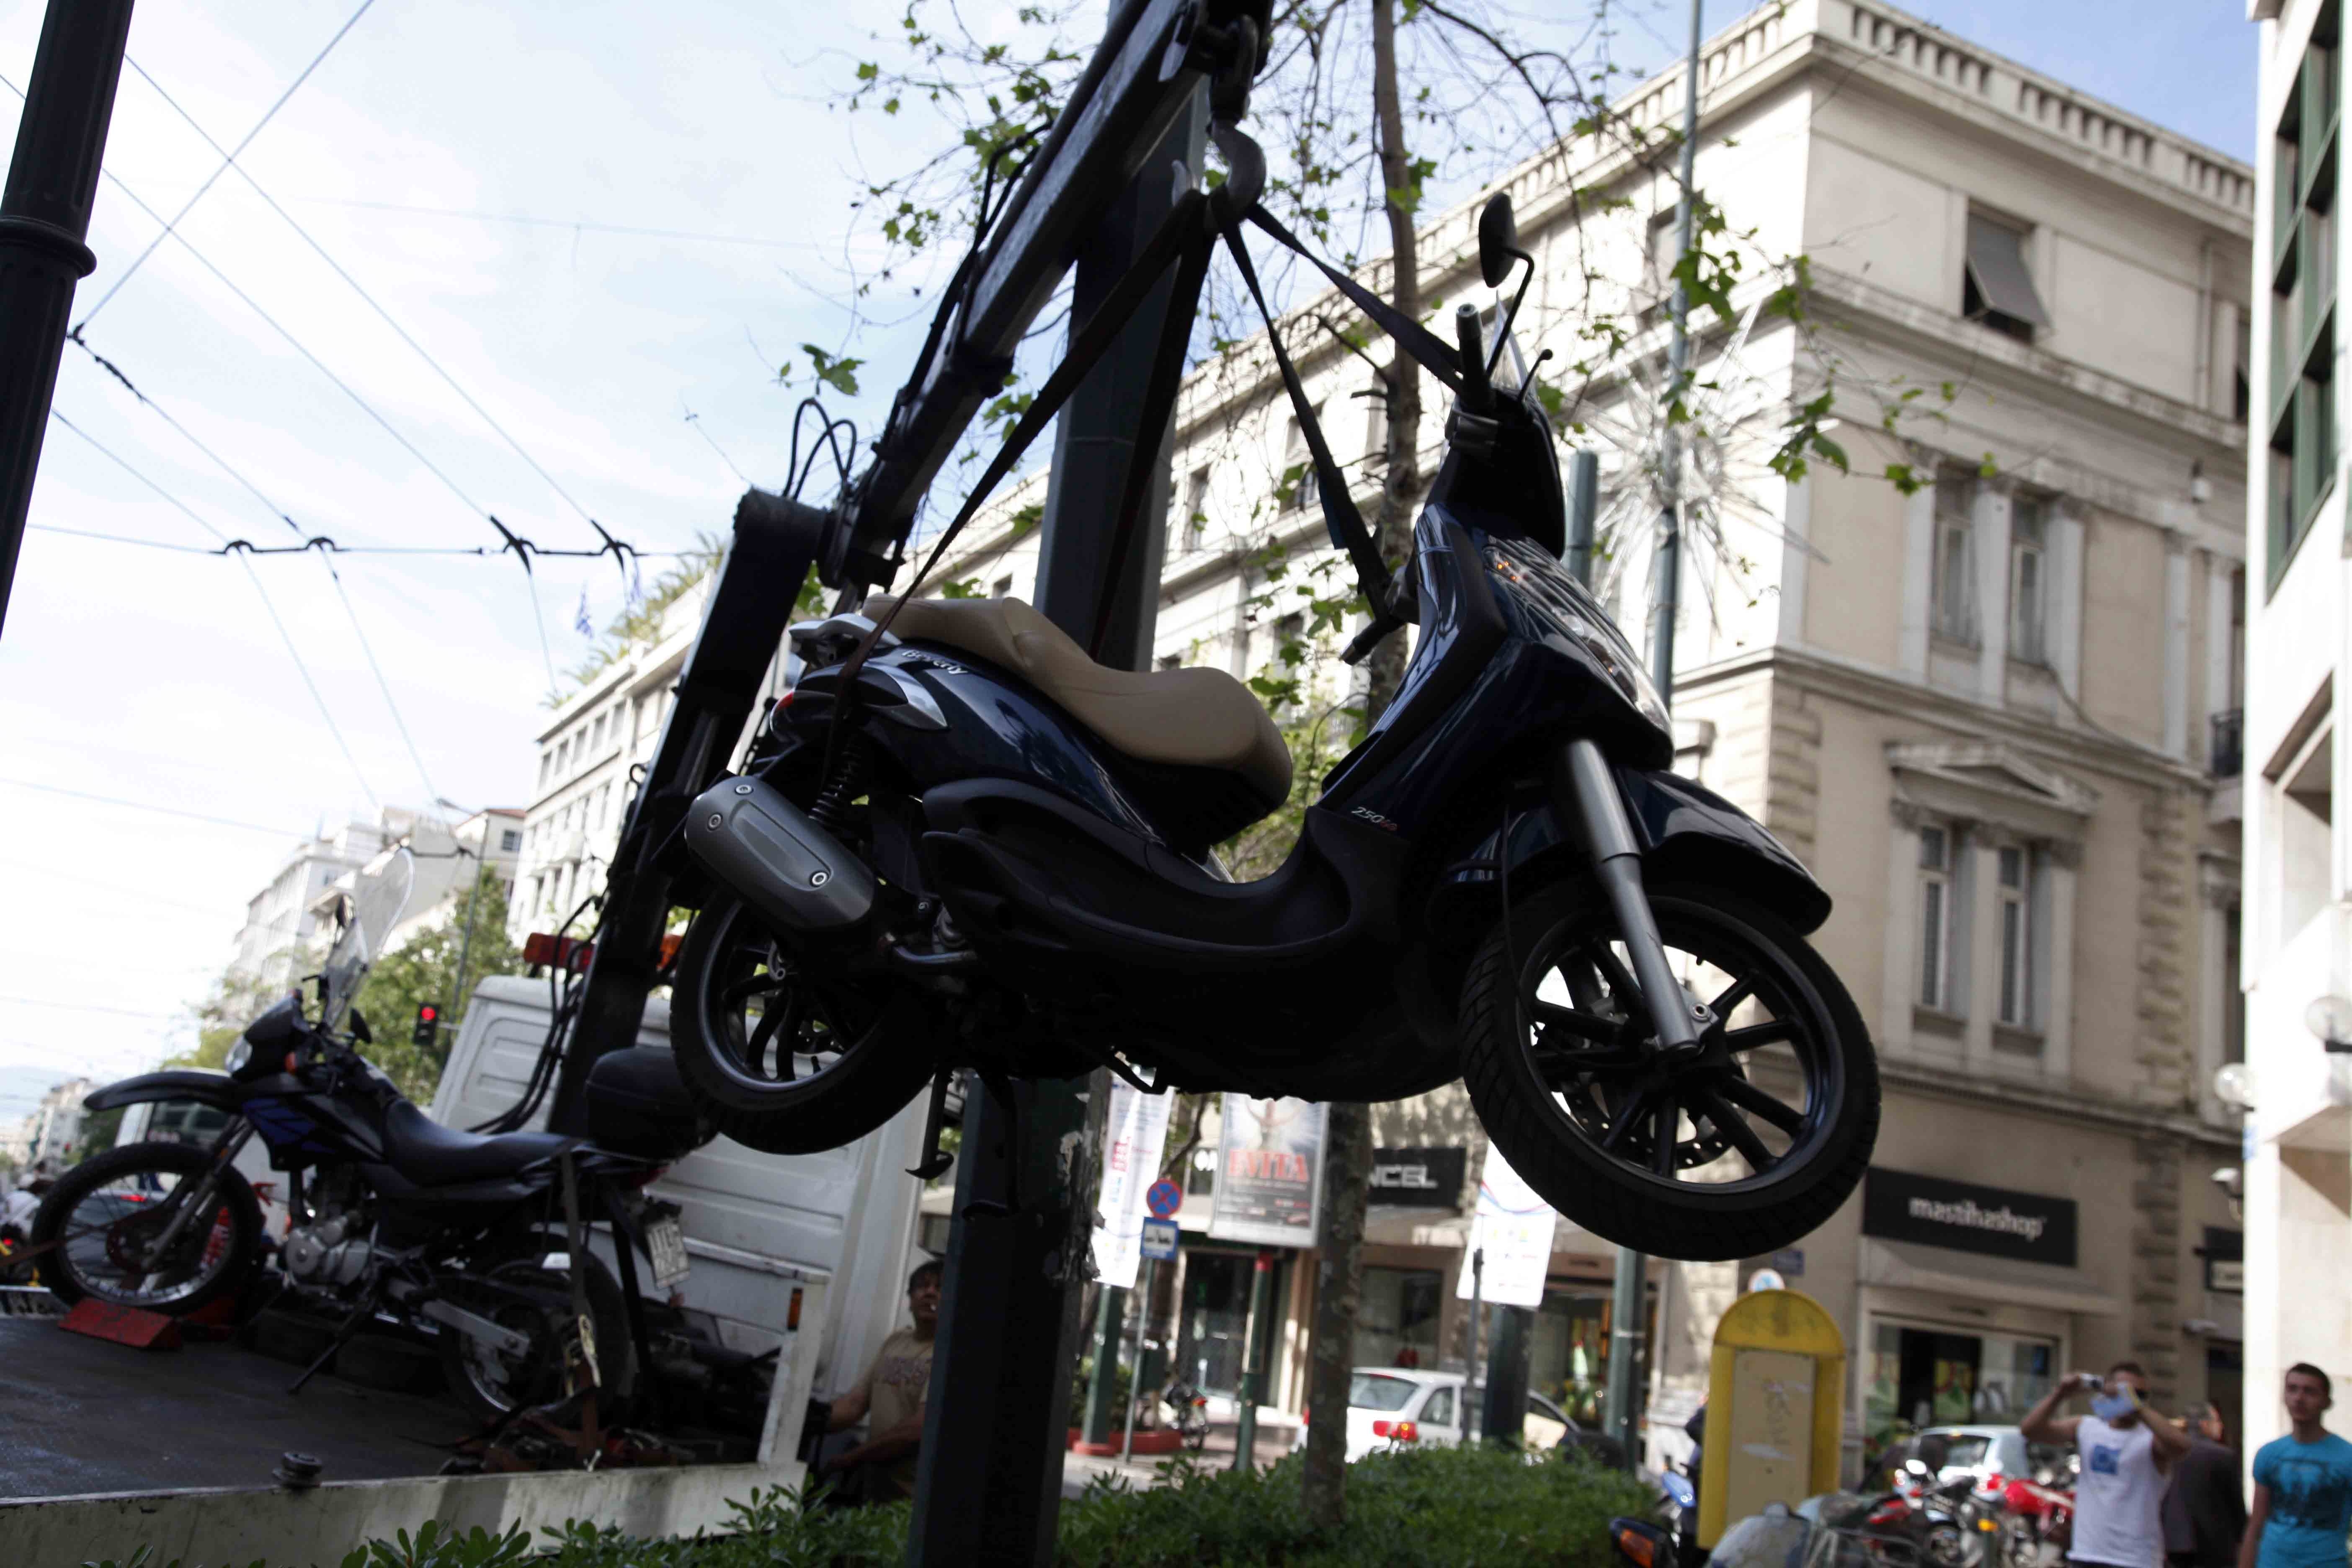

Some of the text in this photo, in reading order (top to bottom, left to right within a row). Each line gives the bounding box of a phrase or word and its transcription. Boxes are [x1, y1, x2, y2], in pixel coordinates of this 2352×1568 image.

[902, 649, 968, 675] Beverly
[1227, 1149, 1309, 1183] EVITA
[1908, 1196, 2044, 1241] mastihashop
